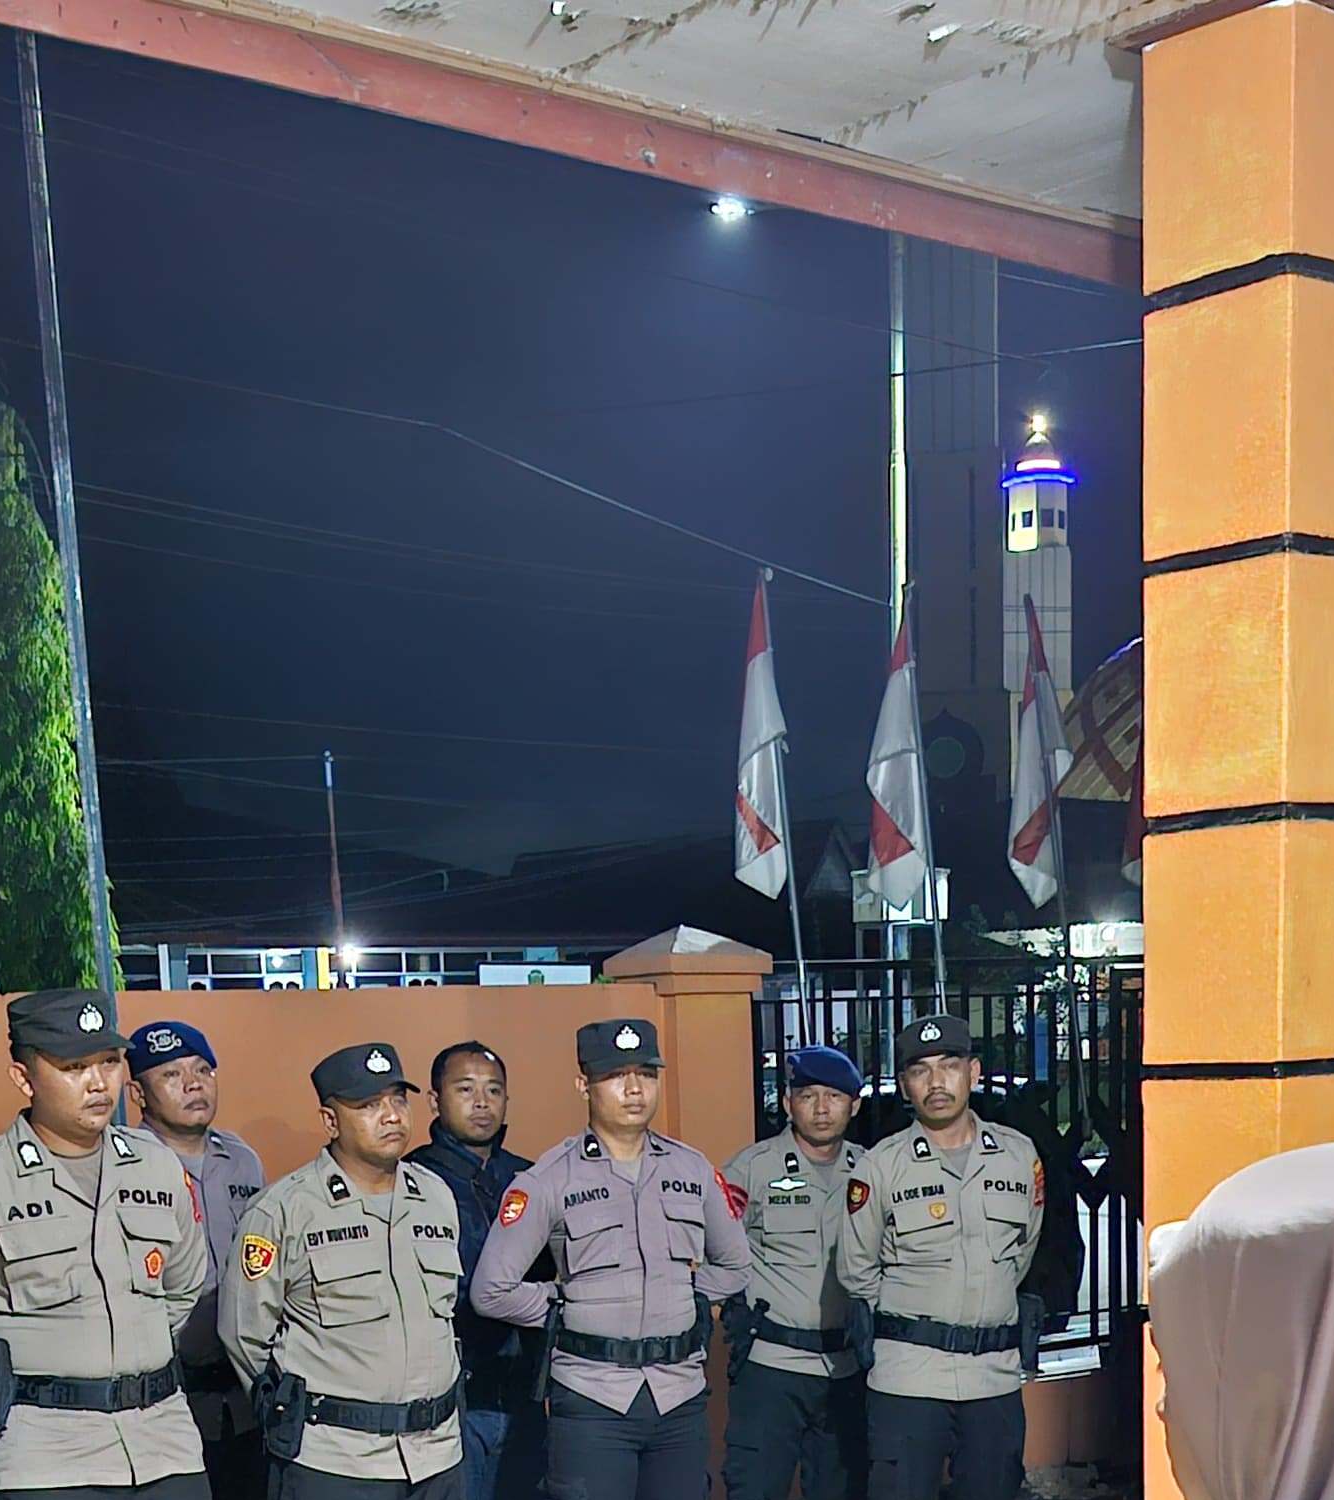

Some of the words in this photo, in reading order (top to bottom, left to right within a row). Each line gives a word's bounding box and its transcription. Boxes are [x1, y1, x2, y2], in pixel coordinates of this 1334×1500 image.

[228, 1184, 260, 1198] POL
[661, 1180, 702, 1197] POLRI
[984, 1179, 1028, 1195] POLRI
[118, 1189, 173, 1208] POLRI
[563, 1187, 610, 1210] ARIANTO
[7, 1200, 54, 1222] ADI
[412, 1224, 455, 1241] POLRI
